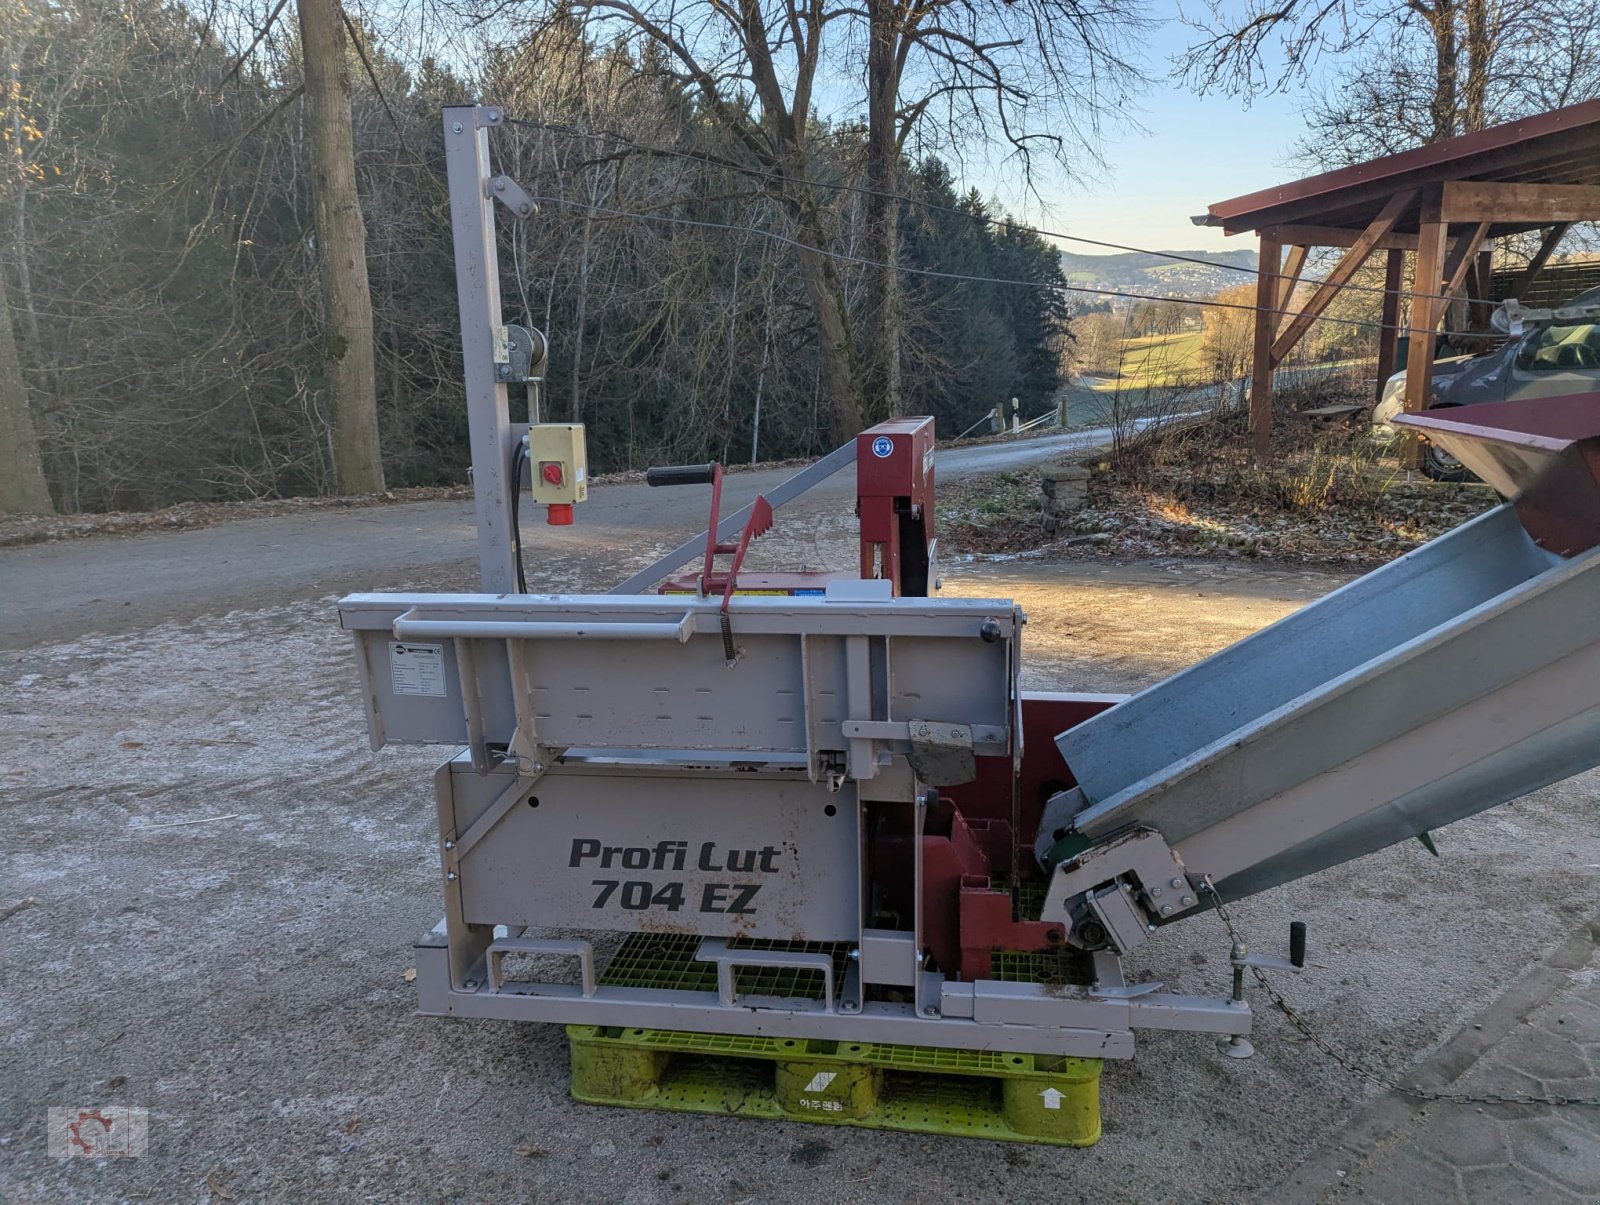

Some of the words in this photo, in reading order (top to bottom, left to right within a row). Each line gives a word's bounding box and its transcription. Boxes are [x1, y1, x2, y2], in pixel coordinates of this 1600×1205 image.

[568, 838, 688, 871] Profi
[591, 879, 686, 912] 704
[699, 883, 763, 914] EZ
